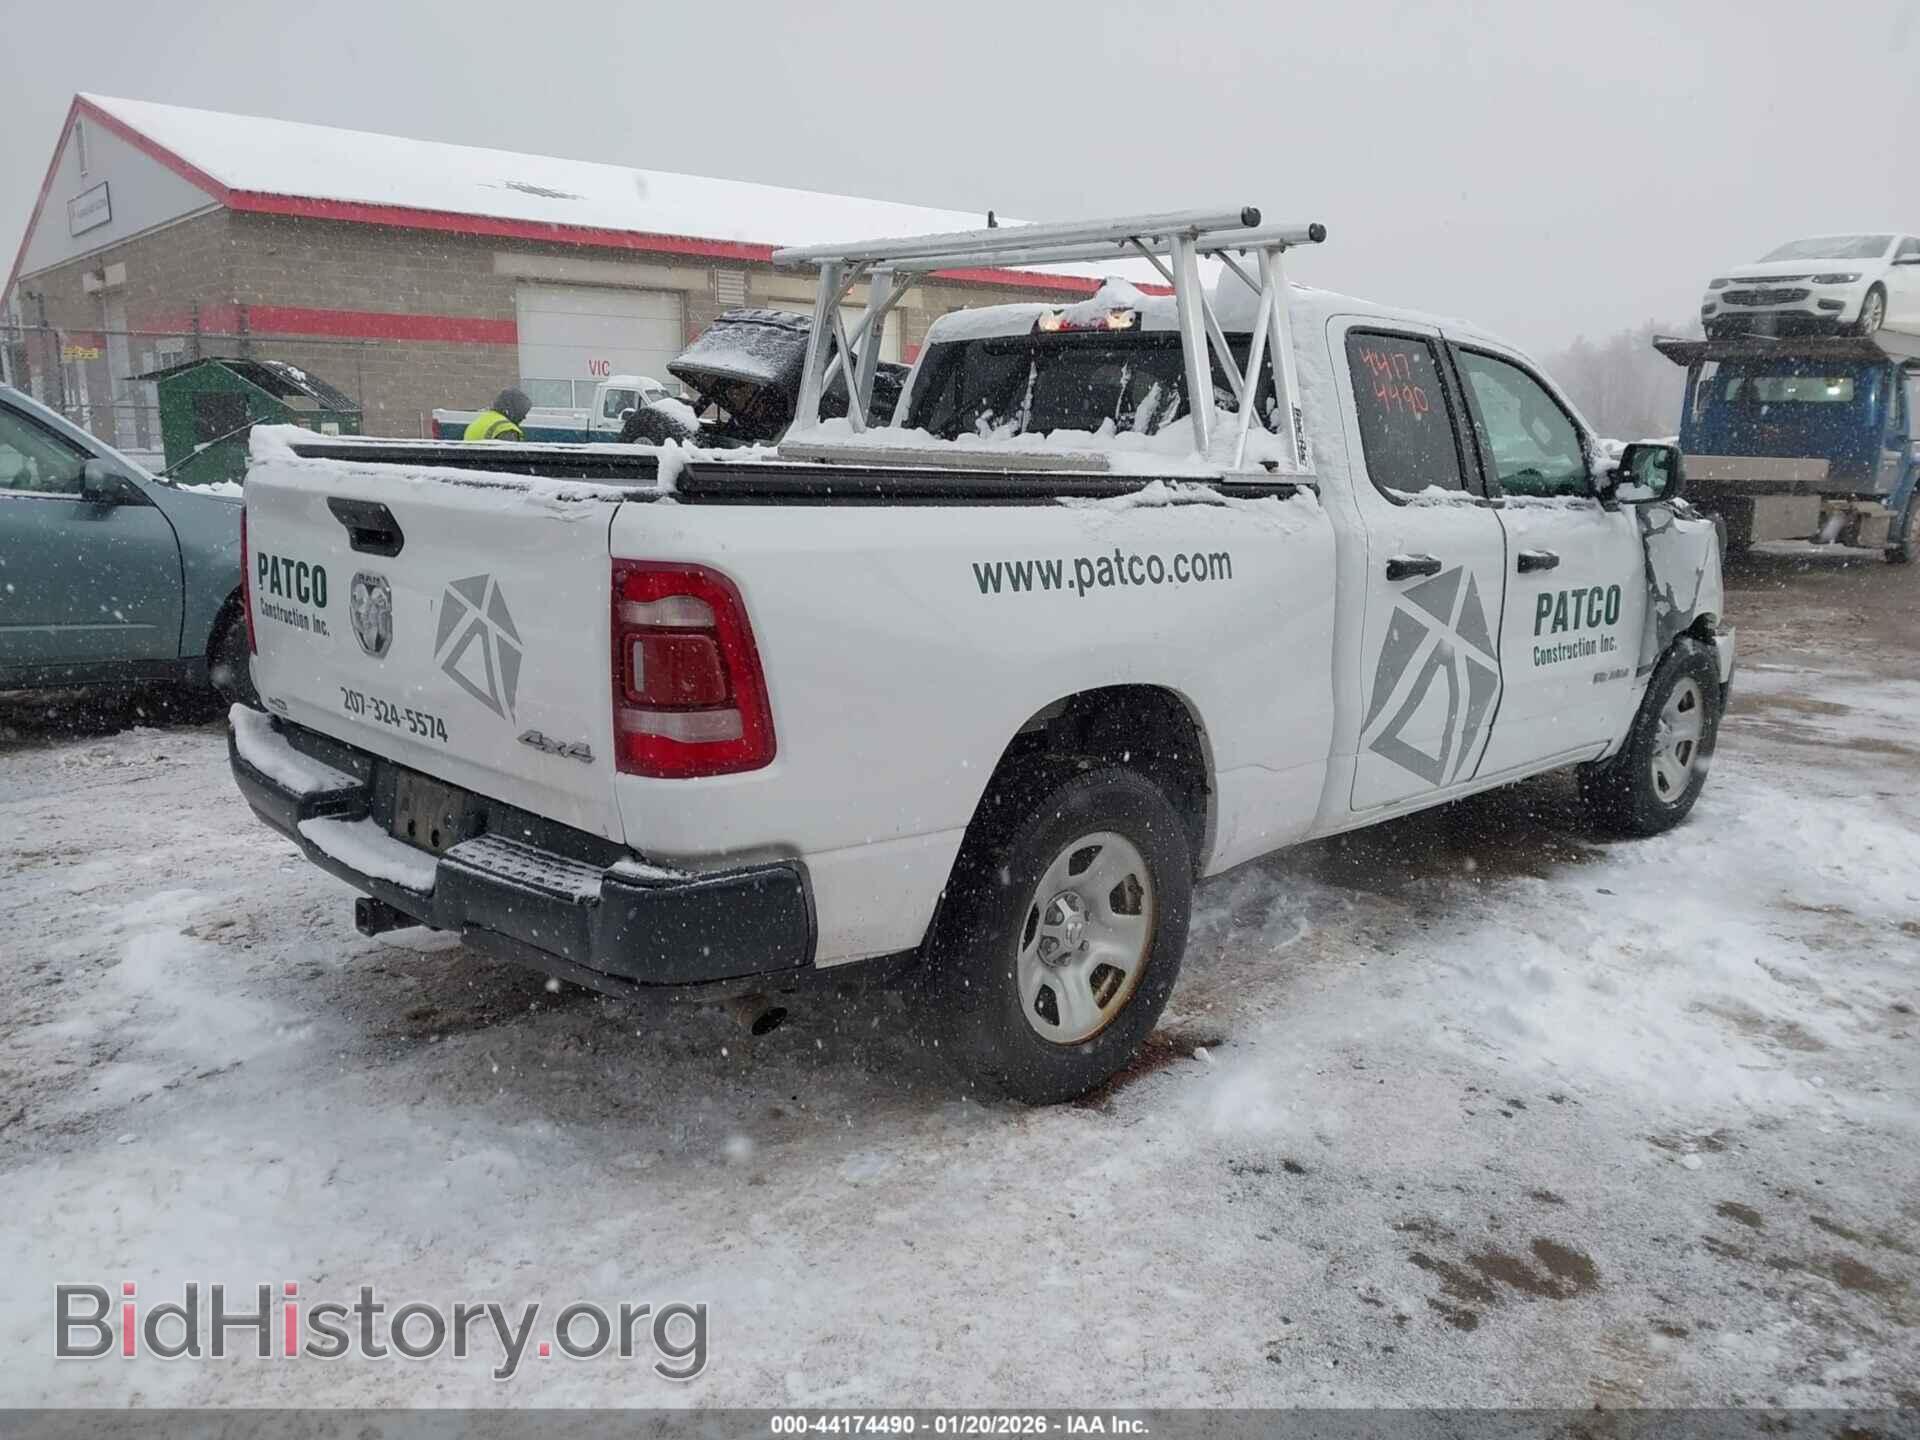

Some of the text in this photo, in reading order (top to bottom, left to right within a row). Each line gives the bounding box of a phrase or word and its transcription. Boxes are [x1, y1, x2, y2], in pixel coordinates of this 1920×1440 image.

[588, 360, 610, 377] VIC
[1374, 383, 1428, 416] 4490
[257, 551, 328, 609] PATCO
[972, 548, 1232, 597] www.patco.com
[260, 597, 331, 637] Construction Inc.
[1534, 584, 1621, 636] PATCO
[1533, 634, 1618, 667] Construction Inc.
[340, 686, 448, 742] 207-324-5574
[517, 729, 596, 764] 4x4
